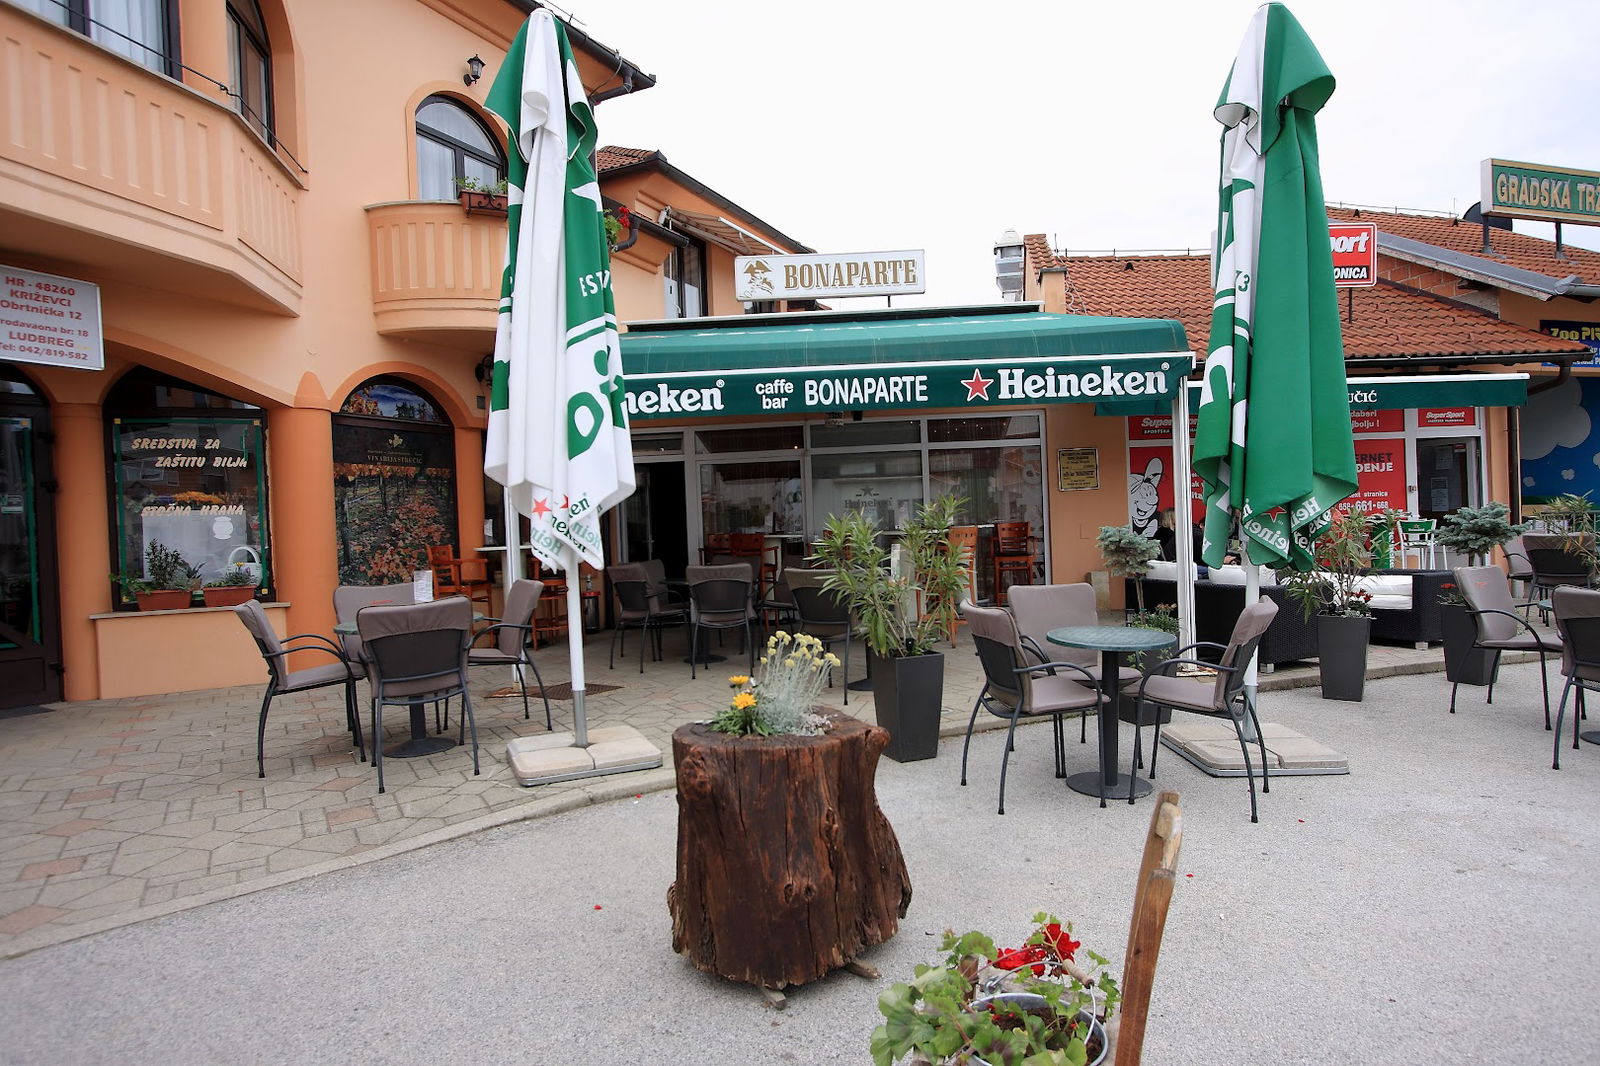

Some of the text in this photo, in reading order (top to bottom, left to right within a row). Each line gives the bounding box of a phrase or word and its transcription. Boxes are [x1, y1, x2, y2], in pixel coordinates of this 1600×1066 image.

[1496, 173, 1571, 210] GRADSKA
[784, 259, 918, 290] BONAPARTE
[1334, 267, 1368, 279] ONICA
[5, 276, 25, 287] HR
[35, 282, 75, 296] 48260
[10, 289, 71, 307] KRIŽEVCI
[0, 299, 82, 320] Obrtnička 12
[60, 326, 74, 335] br:
[9, 331, 74, 348] LUDBREG
[19, 344, 88, 361] 042/819-582
[755, 378, 794, 395] caffe
[804, 375, 928, 406] BONAPARTE
[997, 365, 1169, 399] Heineken
[762, 395, 789, 410] bar
[1425, 411, 1465, 419] SuperSport
[131, 437, 221, 450] SREDSTVA ZA
[155, 453, 248, 468] ZAŠTITU BILJA
[141, 503, 244, 517] STOČNA HRANA
